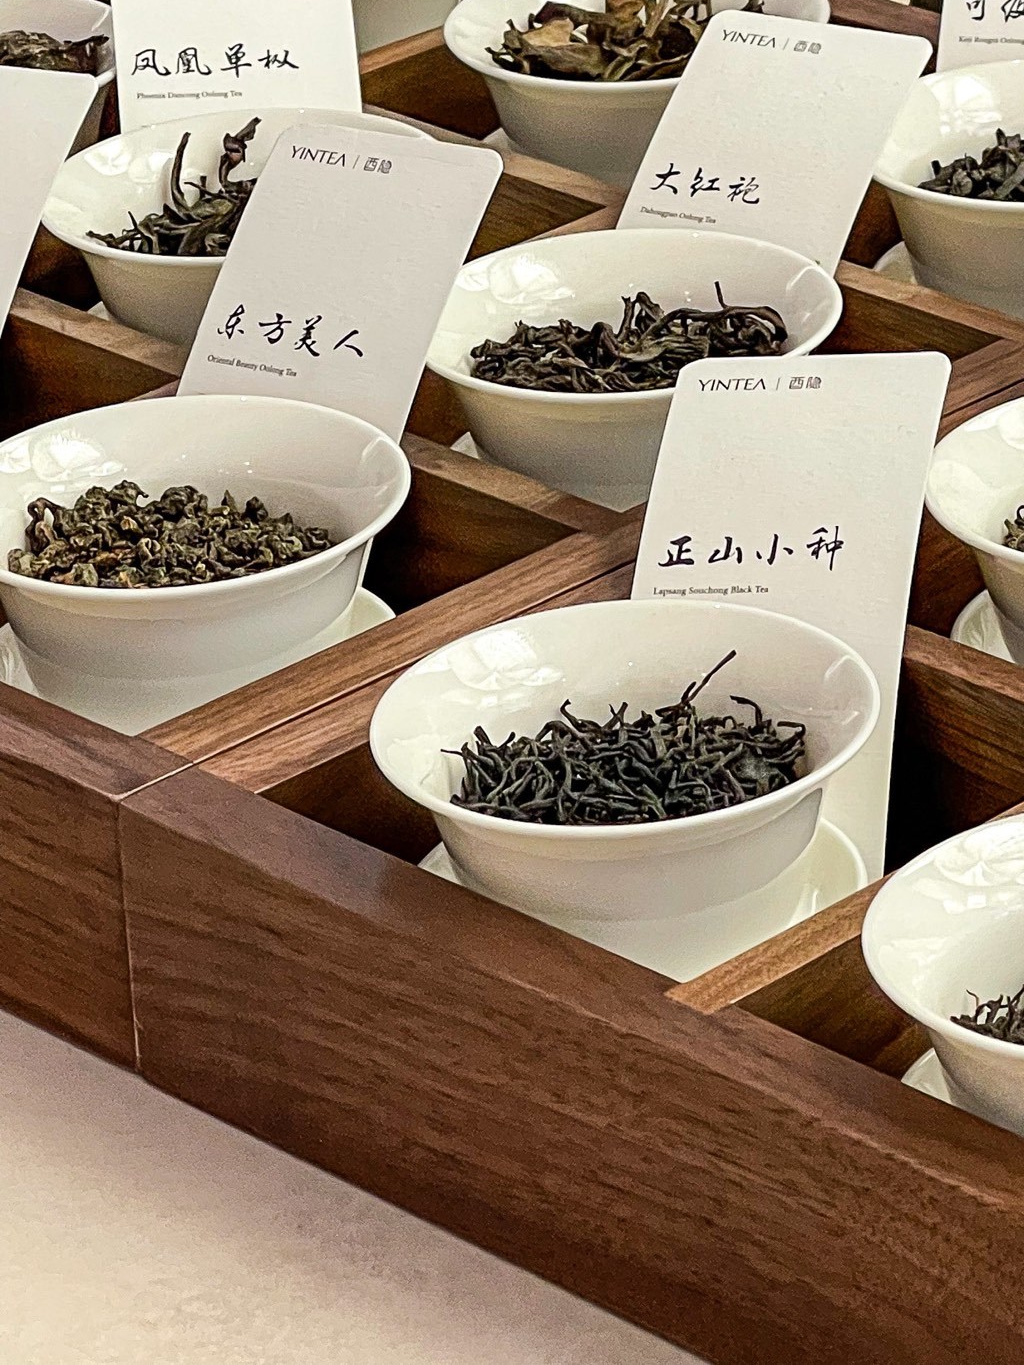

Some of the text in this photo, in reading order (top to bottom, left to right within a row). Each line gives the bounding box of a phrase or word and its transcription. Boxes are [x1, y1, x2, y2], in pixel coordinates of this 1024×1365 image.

[722, 29, 777, 49] YINTEA
[230, 89, 242, 97] Tea
[291, 145, 346, 168] YINTEA
[650, 162, 760, 204] 大红袍
[217, 304, 365, 358] 东方美人
[207, 354, 235, 366] Oriental
[286, 369, 297, 377] Tea
[698, 378, 766, 391] YINTEA
[658, 525, 844, 571] 正山小种
[653, 585, 769, 596] Lapsang Souchong Black Tea
